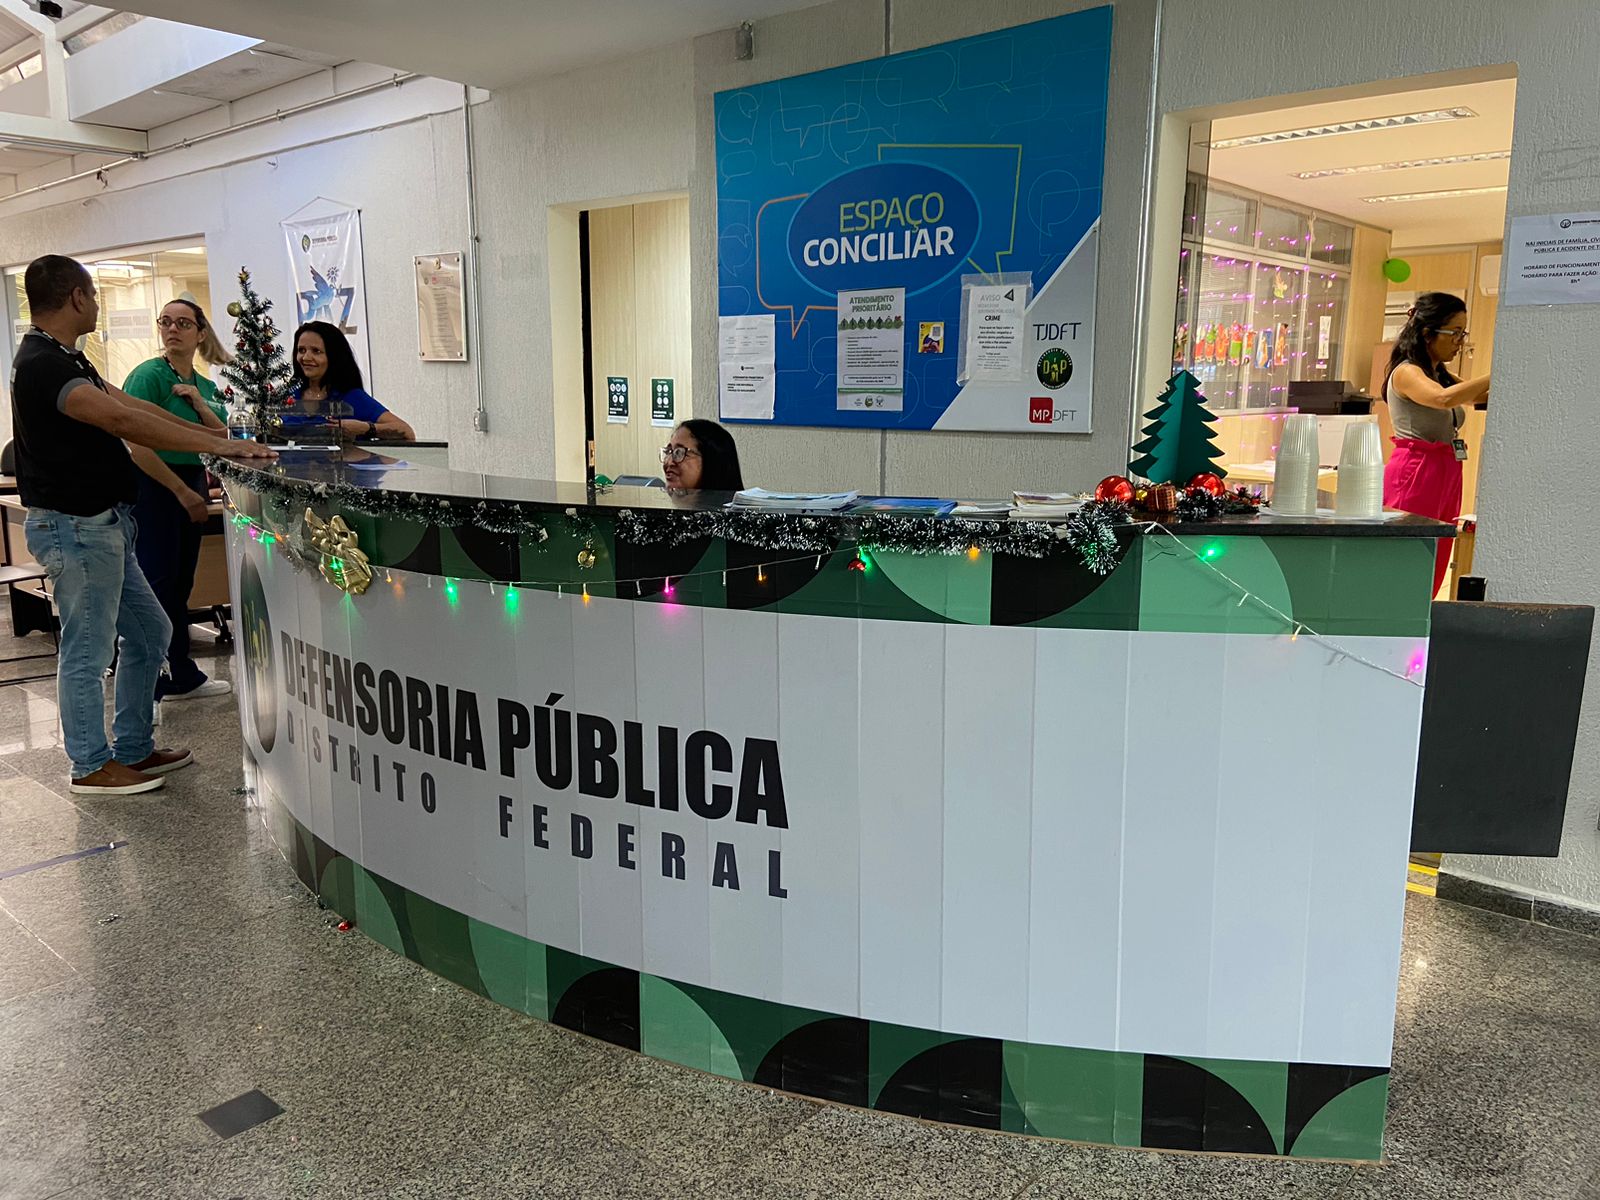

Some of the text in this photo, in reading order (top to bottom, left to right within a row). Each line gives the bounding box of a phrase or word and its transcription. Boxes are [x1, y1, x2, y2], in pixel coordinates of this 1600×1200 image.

[839, 191, 944, 234] ESPAÇO
[803, 226, 955, 267] CONCILIAR
[1536, 239, 1557, 247] INICIAIS
[849, 294, 895, 304] ATENDIMENTO
[852, 303, 892, 312] PRIORITÁRIO
[980, 294, 1001, 302] AVISO
[1033, 322, 1082, 341] TJDFT
[281, 630, 789, 829] DEFENSORIA PÚBLICA
[287, 709, 788, 899] DISTRITO FEDERAL
